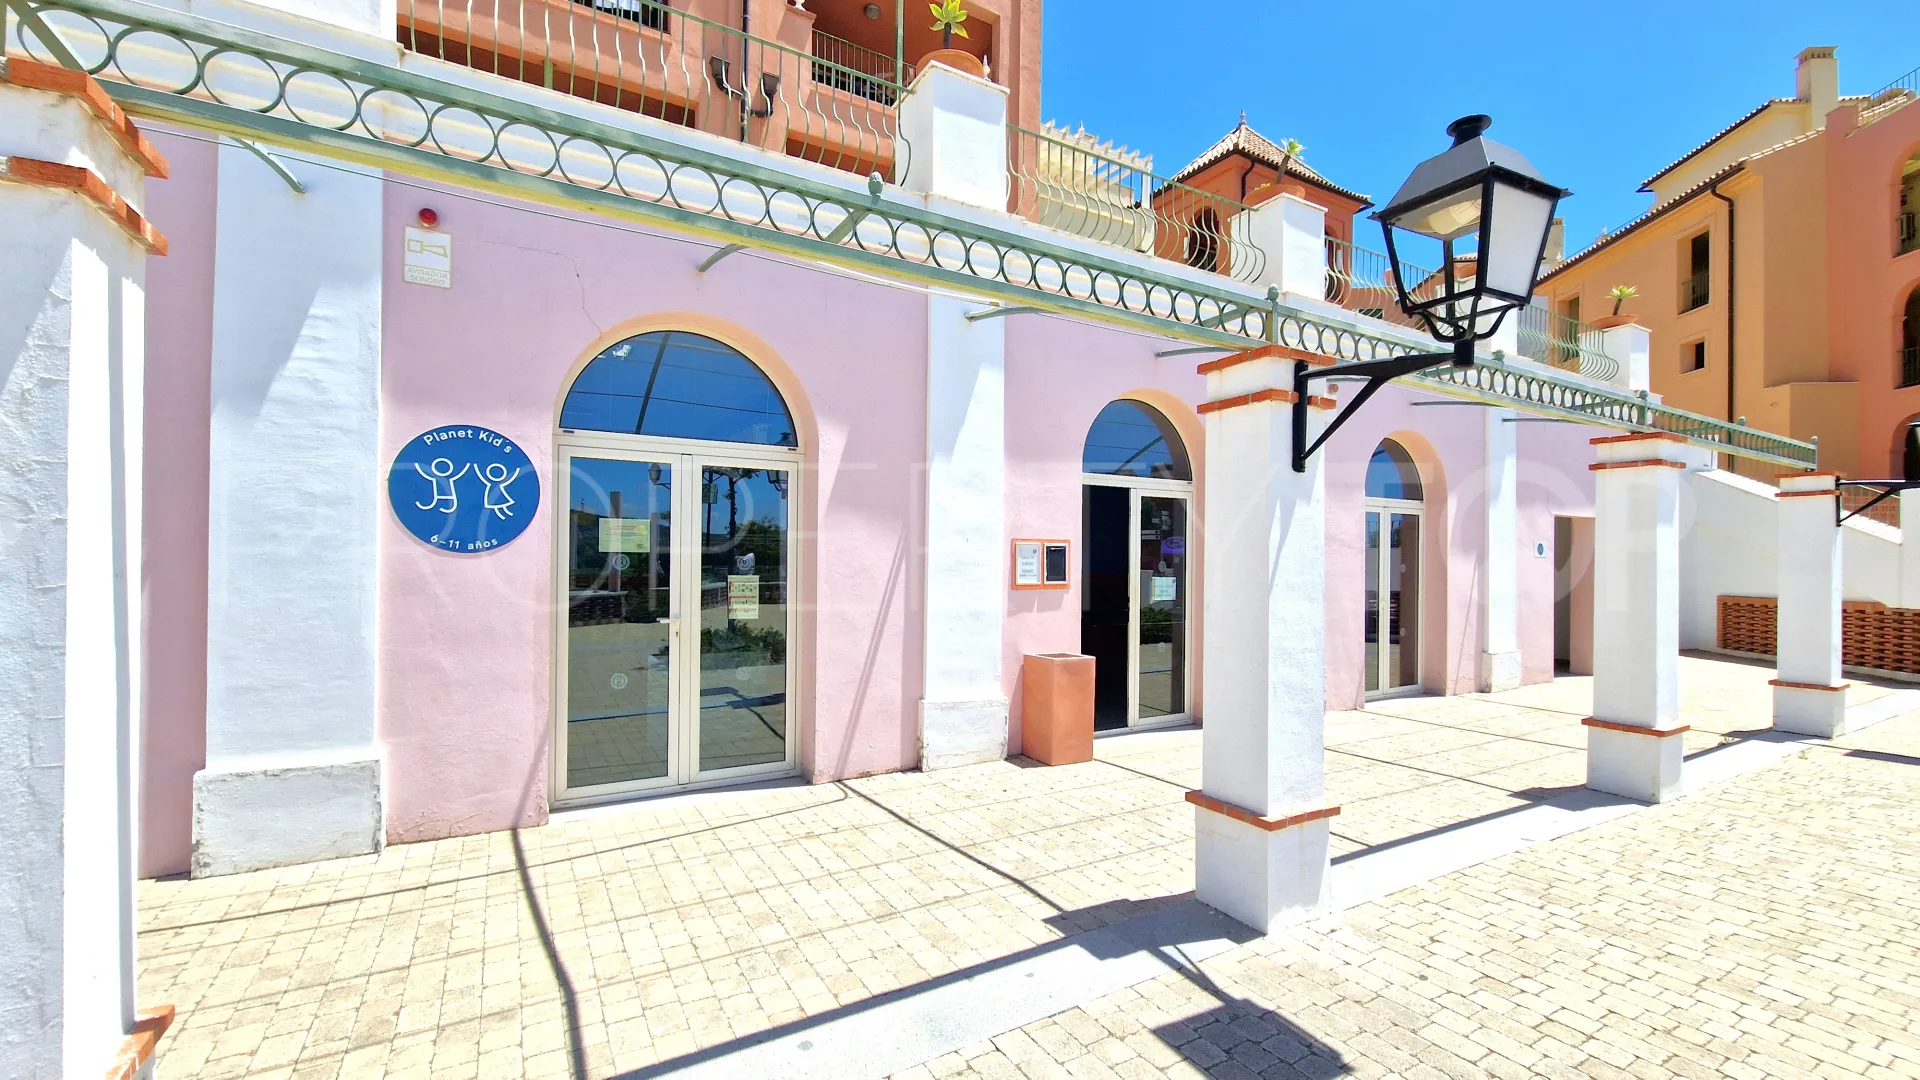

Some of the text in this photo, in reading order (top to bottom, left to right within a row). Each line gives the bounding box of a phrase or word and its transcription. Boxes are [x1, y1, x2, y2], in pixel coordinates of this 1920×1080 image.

[407, 267, 448, 280] AVISADOR
[410, 274, 445, 286] SONORO
[423, 429, 473, 446] Planet
[430, 534, 498, 550] 6-11 años
